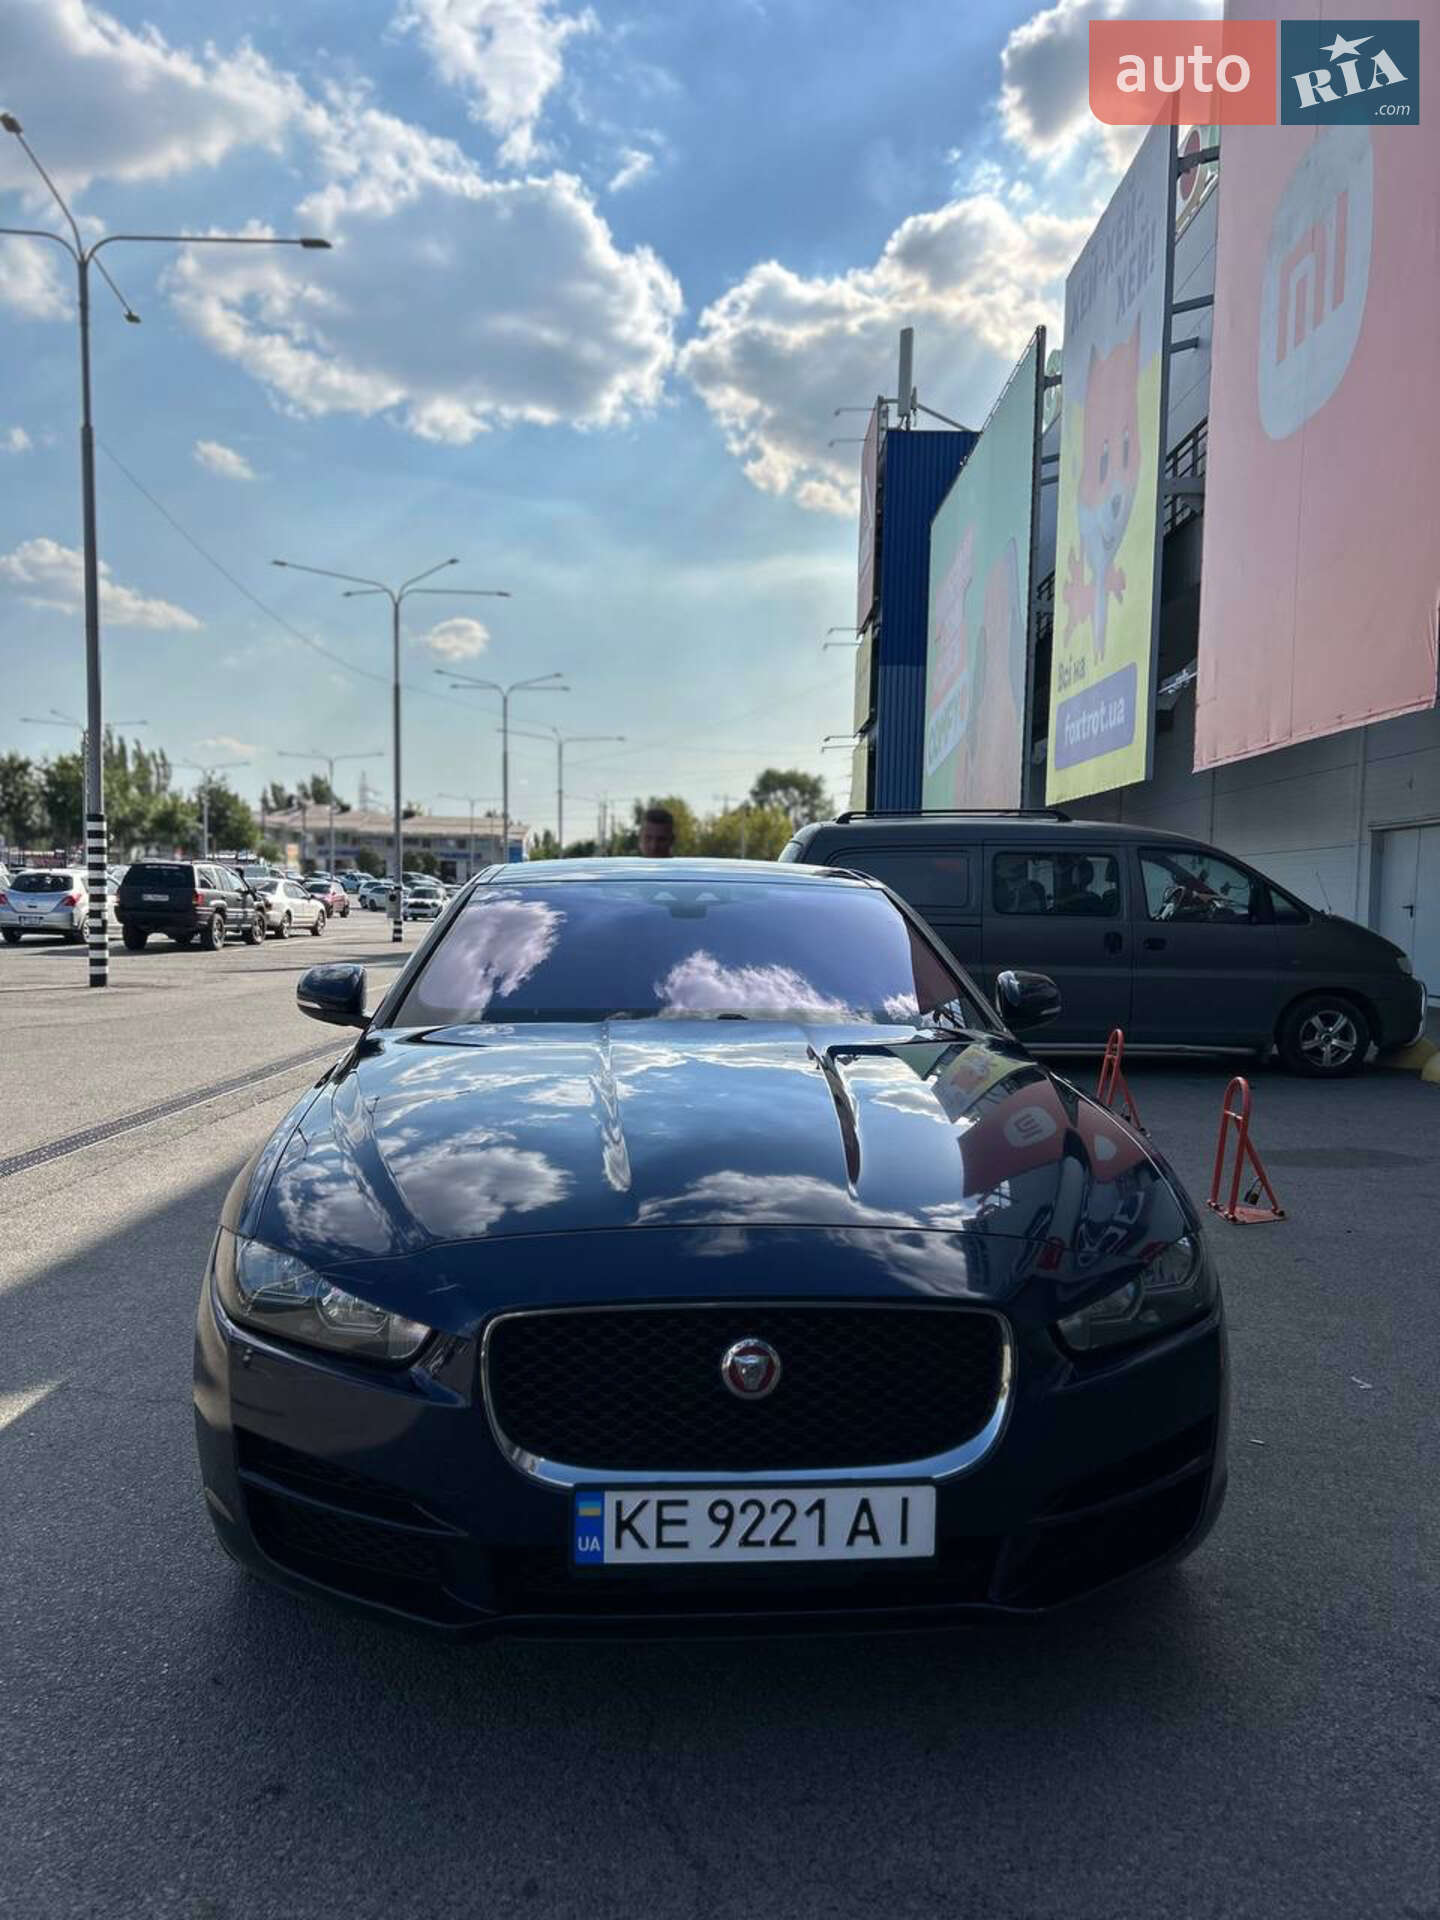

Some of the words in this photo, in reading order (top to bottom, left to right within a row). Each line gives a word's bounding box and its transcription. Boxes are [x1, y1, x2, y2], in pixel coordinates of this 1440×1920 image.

[1064, 696, 1125, 745] foxtrot.ua
[578, 1536, 601, 1551] UA
[614, 1500, 689, 1549] KE
[707, 1498, 826, 1548] 9221
